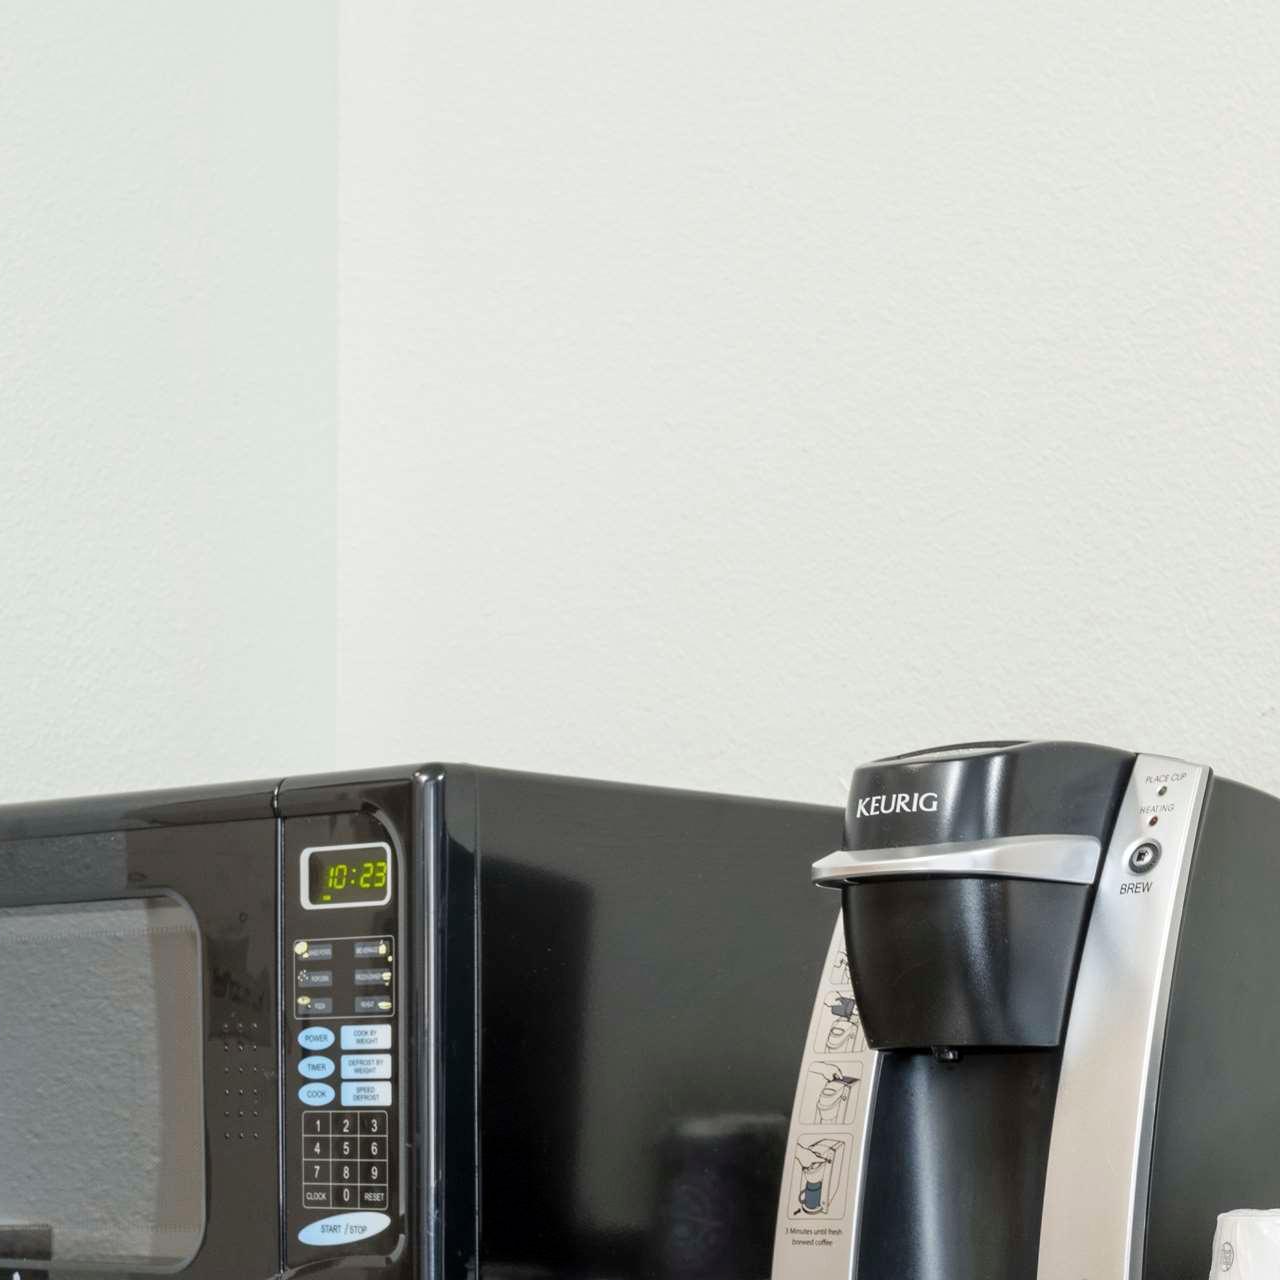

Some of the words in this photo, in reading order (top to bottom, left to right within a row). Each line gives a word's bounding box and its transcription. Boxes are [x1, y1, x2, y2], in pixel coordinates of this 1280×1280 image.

[1145, 774, 1169, 784] PLACE
[1170, 772, 1187, 781] CUP
[856, 792, 939, 819] KEURIG
[1140, 803, 1175, 814] HEATING
[328, 861, 388, 890] 10:23
[1119, 881, 1153, 895] BREW
[303, 1033, 329, 1043] POWER
[307, 1063, 327, 1072] TIMER
[306, 1089, 327, 1099] COOK
[315, 1119, 321, 1133] 1
[342, 1119, 350, 1133] 2
[370, 1119, 378, 1133] 3
[313, 1142, 321, 1156] 4
[342, 1142, 350, 1156] 5
[370, 1142, 378, 1156] 6
[313, 1165, 321, 1179] 7
[342, 1166, 350, 1180] 8
[370, 1166, 378, 1180] 9
[306, 1191, 328, 1201] CLOCK
[342, 1188, 350, 1202] 0
[364, 1192, 385, 1202] RESET
[320, 1224, 342, 1234] START
